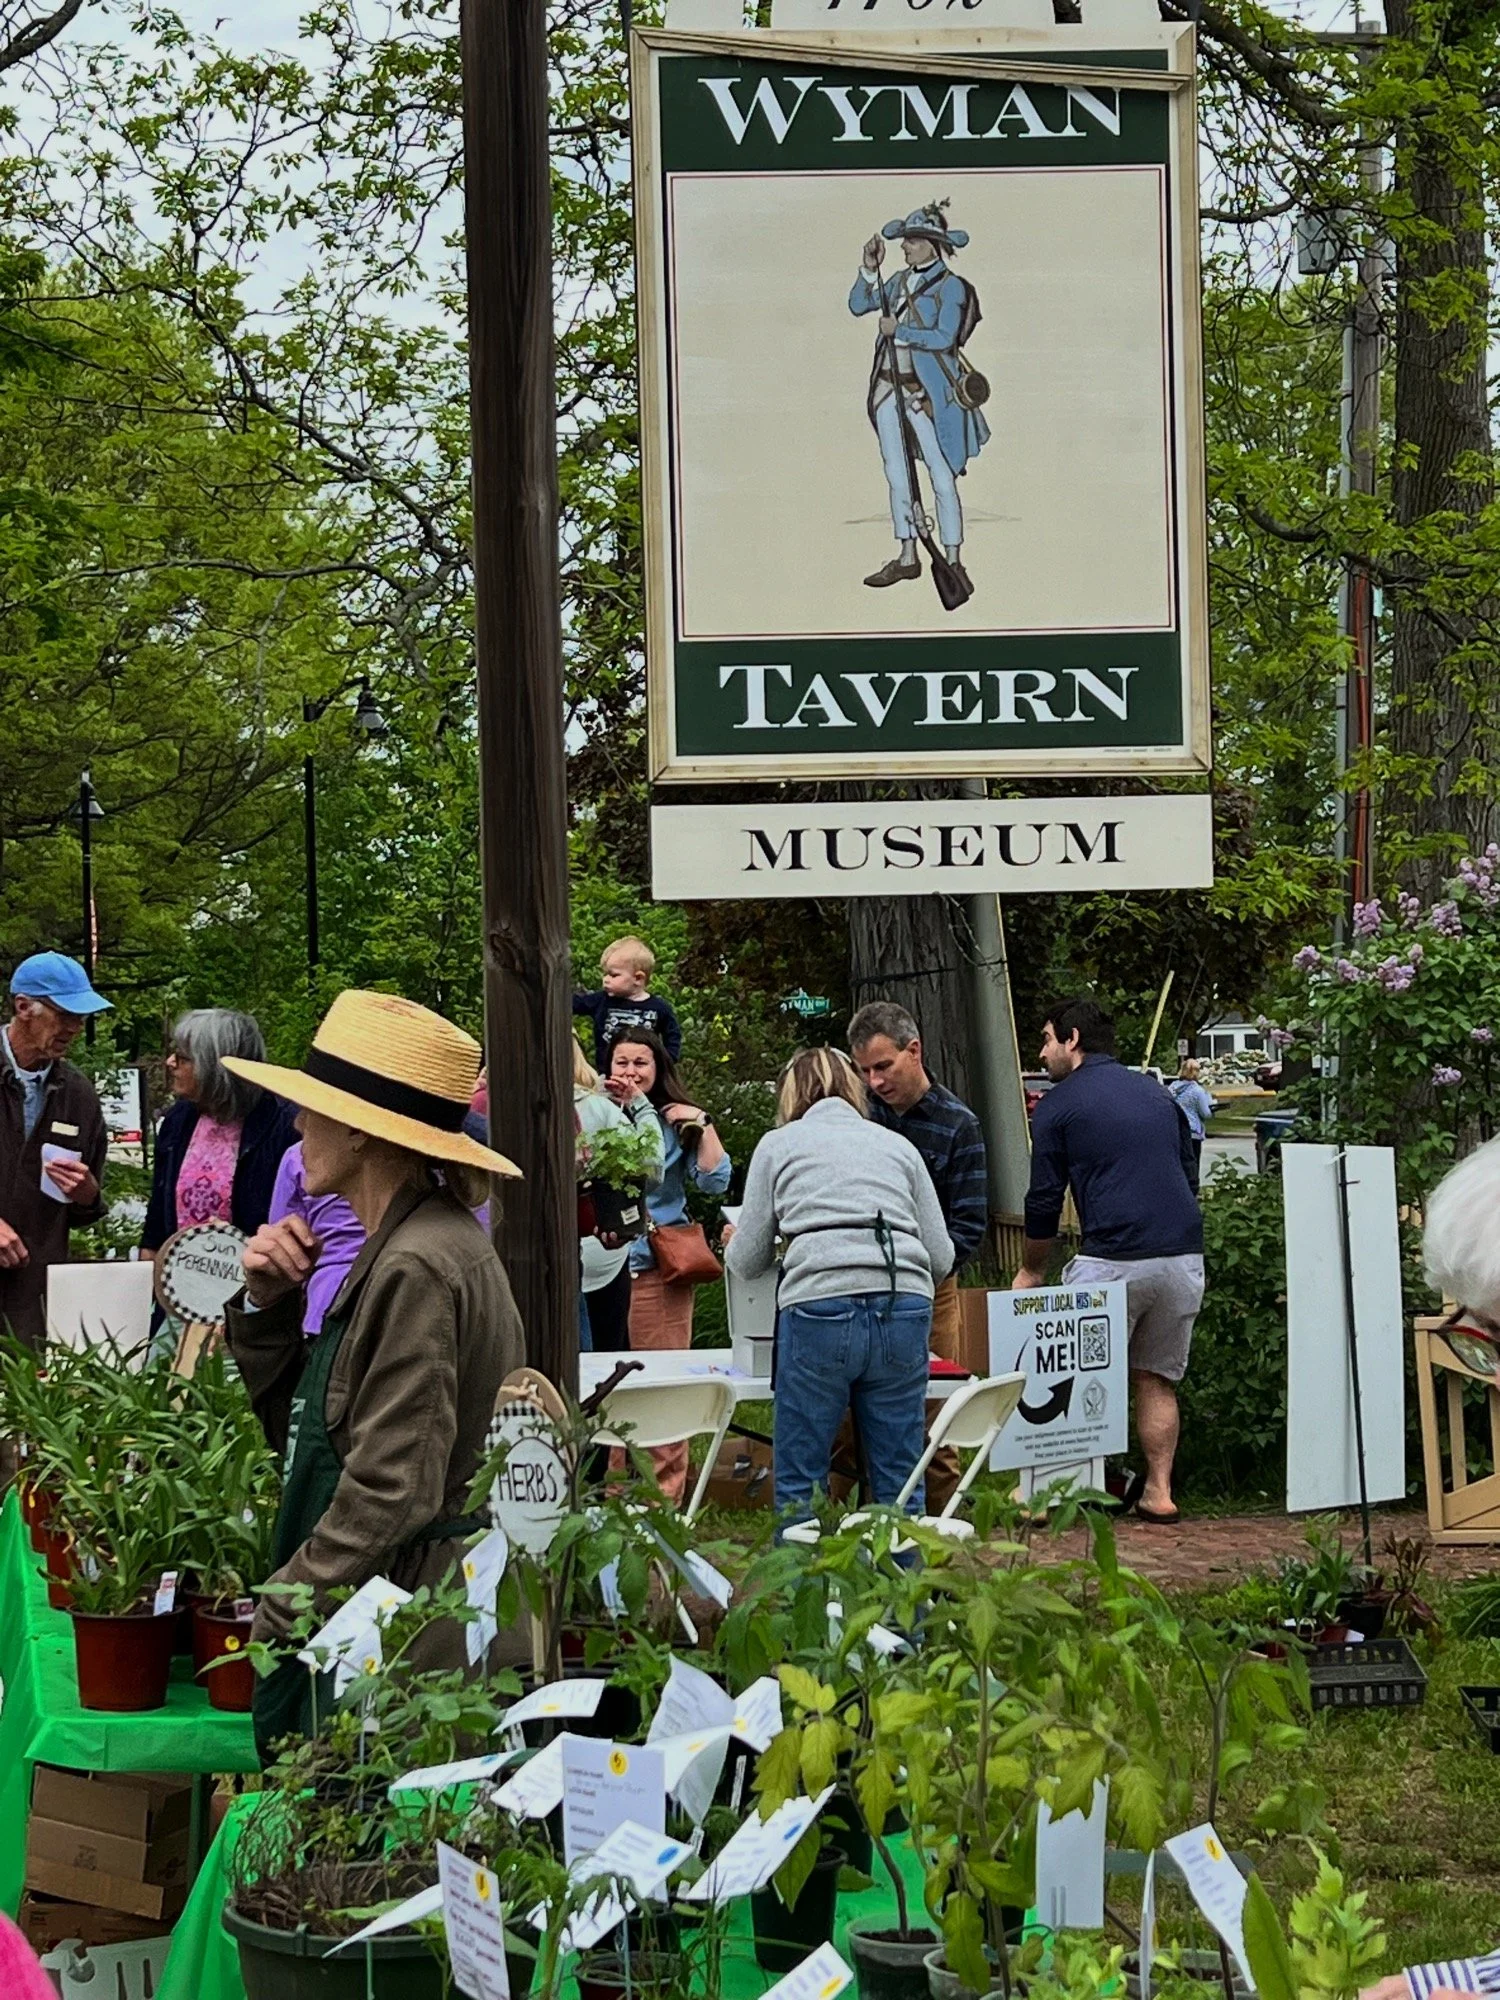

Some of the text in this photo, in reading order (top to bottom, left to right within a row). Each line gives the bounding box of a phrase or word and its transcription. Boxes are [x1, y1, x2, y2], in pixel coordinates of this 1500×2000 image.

[697, 76, 1122, 145] WYMAN
[719, 664, 1139, 729] TAVERN
[741, 820, 1125, 872] MUSEUM
[202, 1234, 236, 1257] Sun
[1013, 1296, 1049, 1316] SUPPORT
[1052, 1292, 1075, 1312] LOCAL
[1036, 1319, 1075, 1340] SCAN
[1036, 1342, 1075, 1374] ME!
[498, 1462, 557, 1503] HERBS
